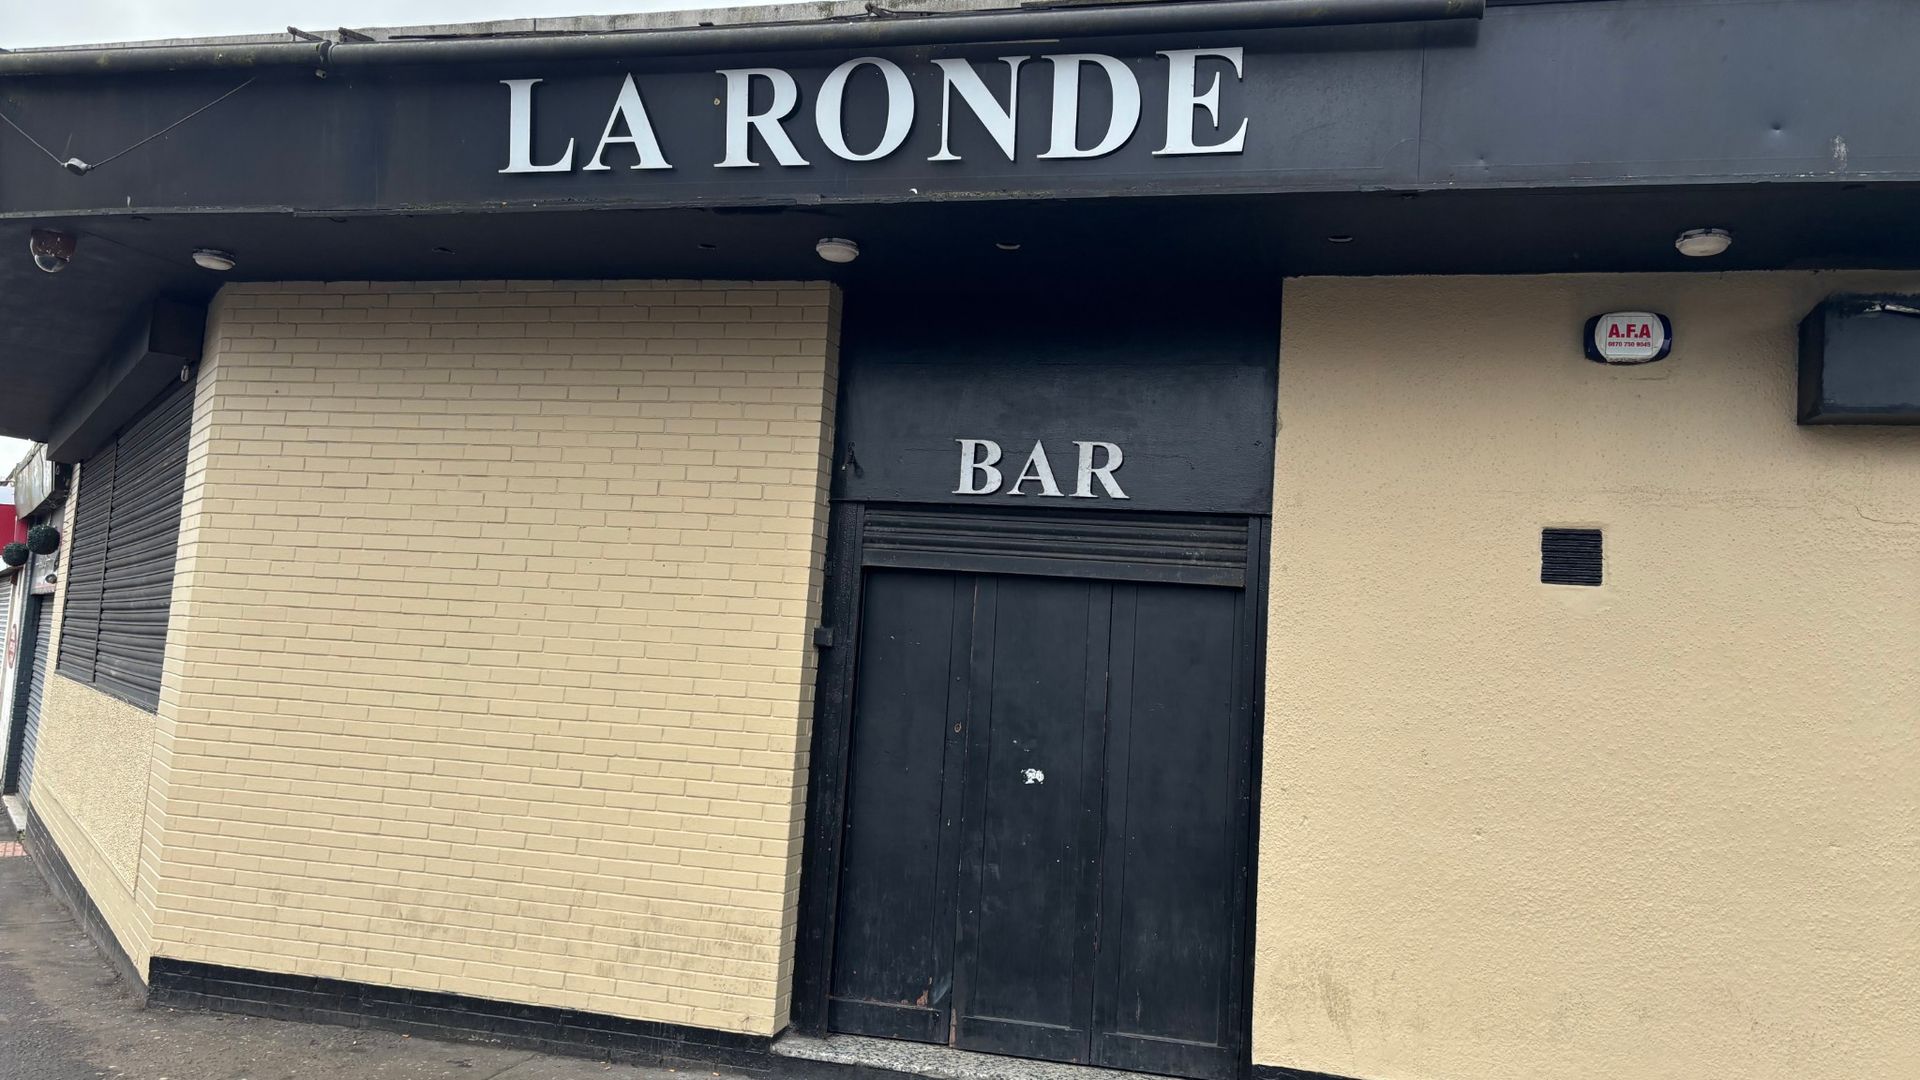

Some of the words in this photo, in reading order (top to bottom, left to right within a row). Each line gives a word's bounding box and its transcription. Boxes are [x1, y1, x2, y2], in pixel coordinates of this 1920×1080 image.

[499, 73, 673, 174] LA
[714, 47, 1249, 168] RONDE
[1608, 323, 1651, 338] A.F.A
[952, 439, 1130, 499] BAR
